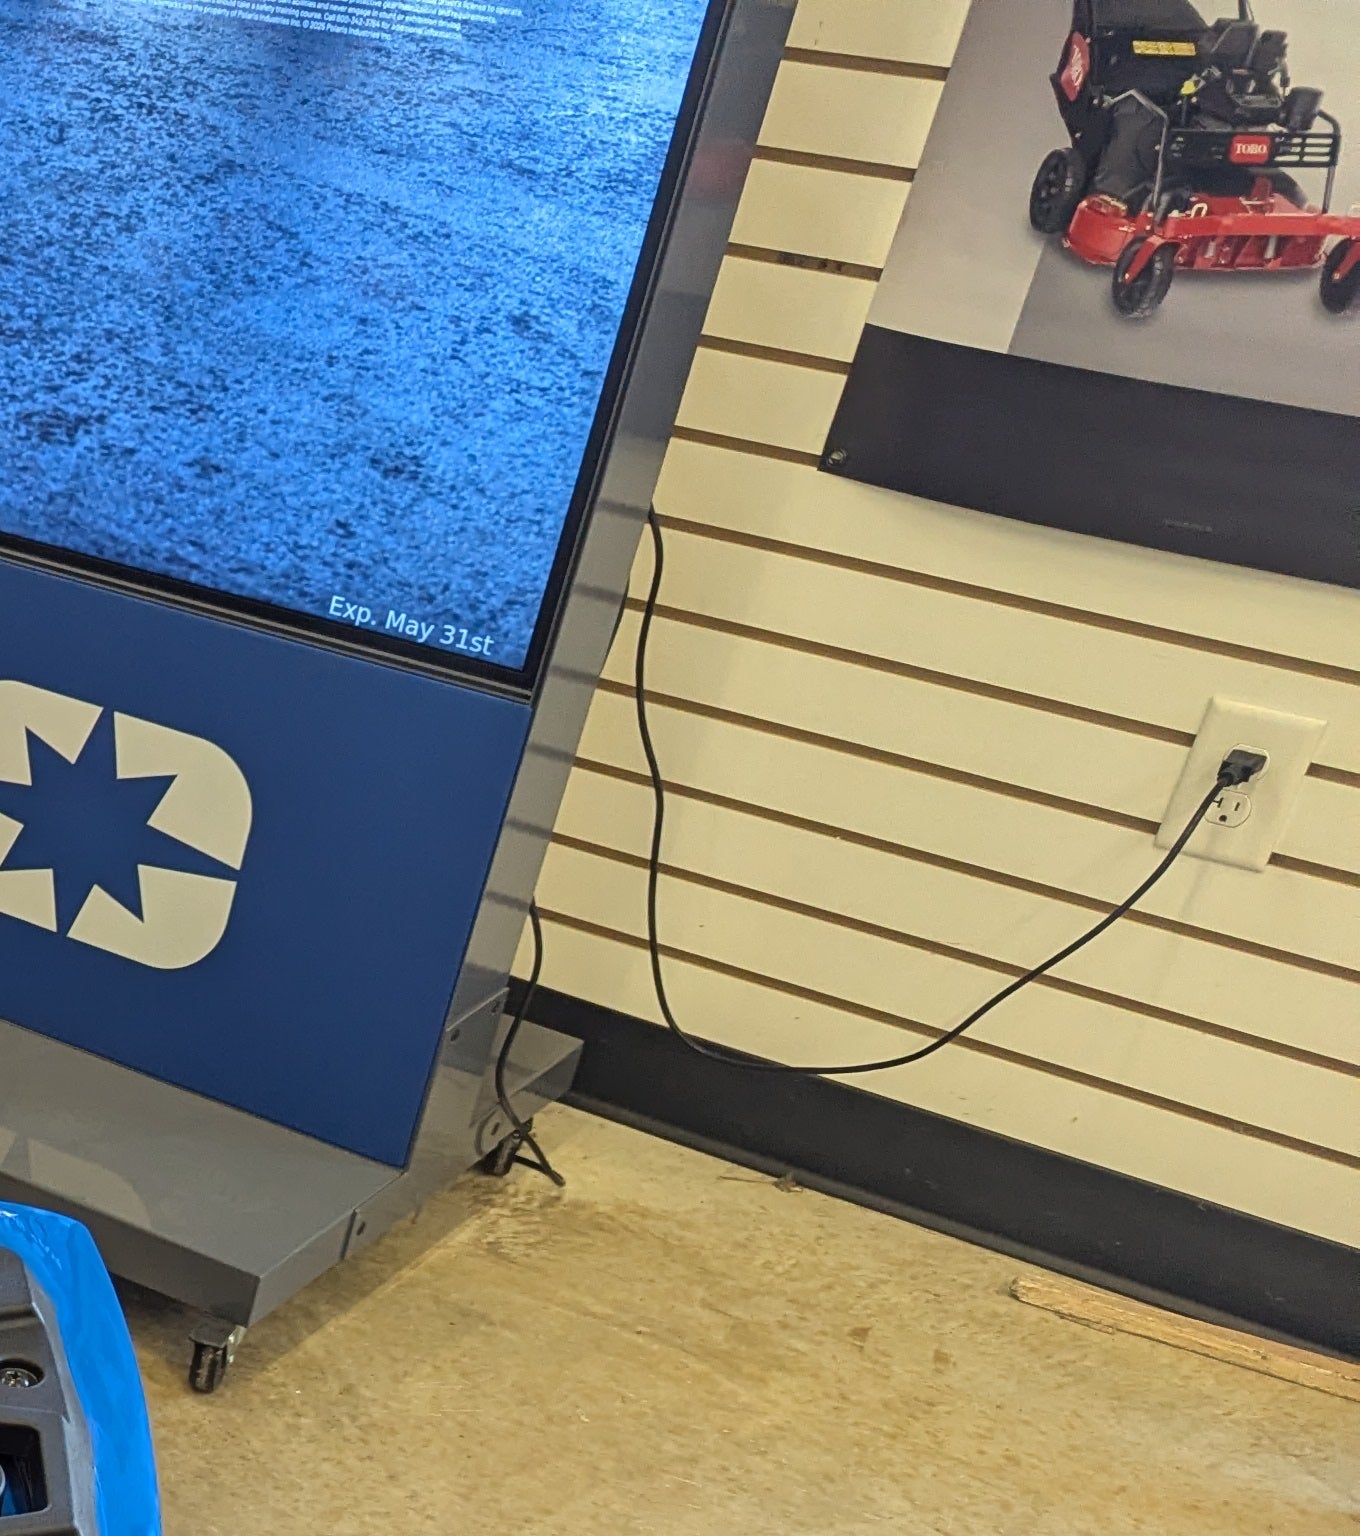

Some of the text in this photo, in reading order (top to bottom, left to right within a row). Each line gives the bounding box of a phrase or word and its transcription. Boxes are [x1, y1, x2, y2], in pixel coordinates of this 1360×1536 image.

[1234, 142, 1268, 155] TORO
[329, 595, 494, 656] Exp. May 31st
